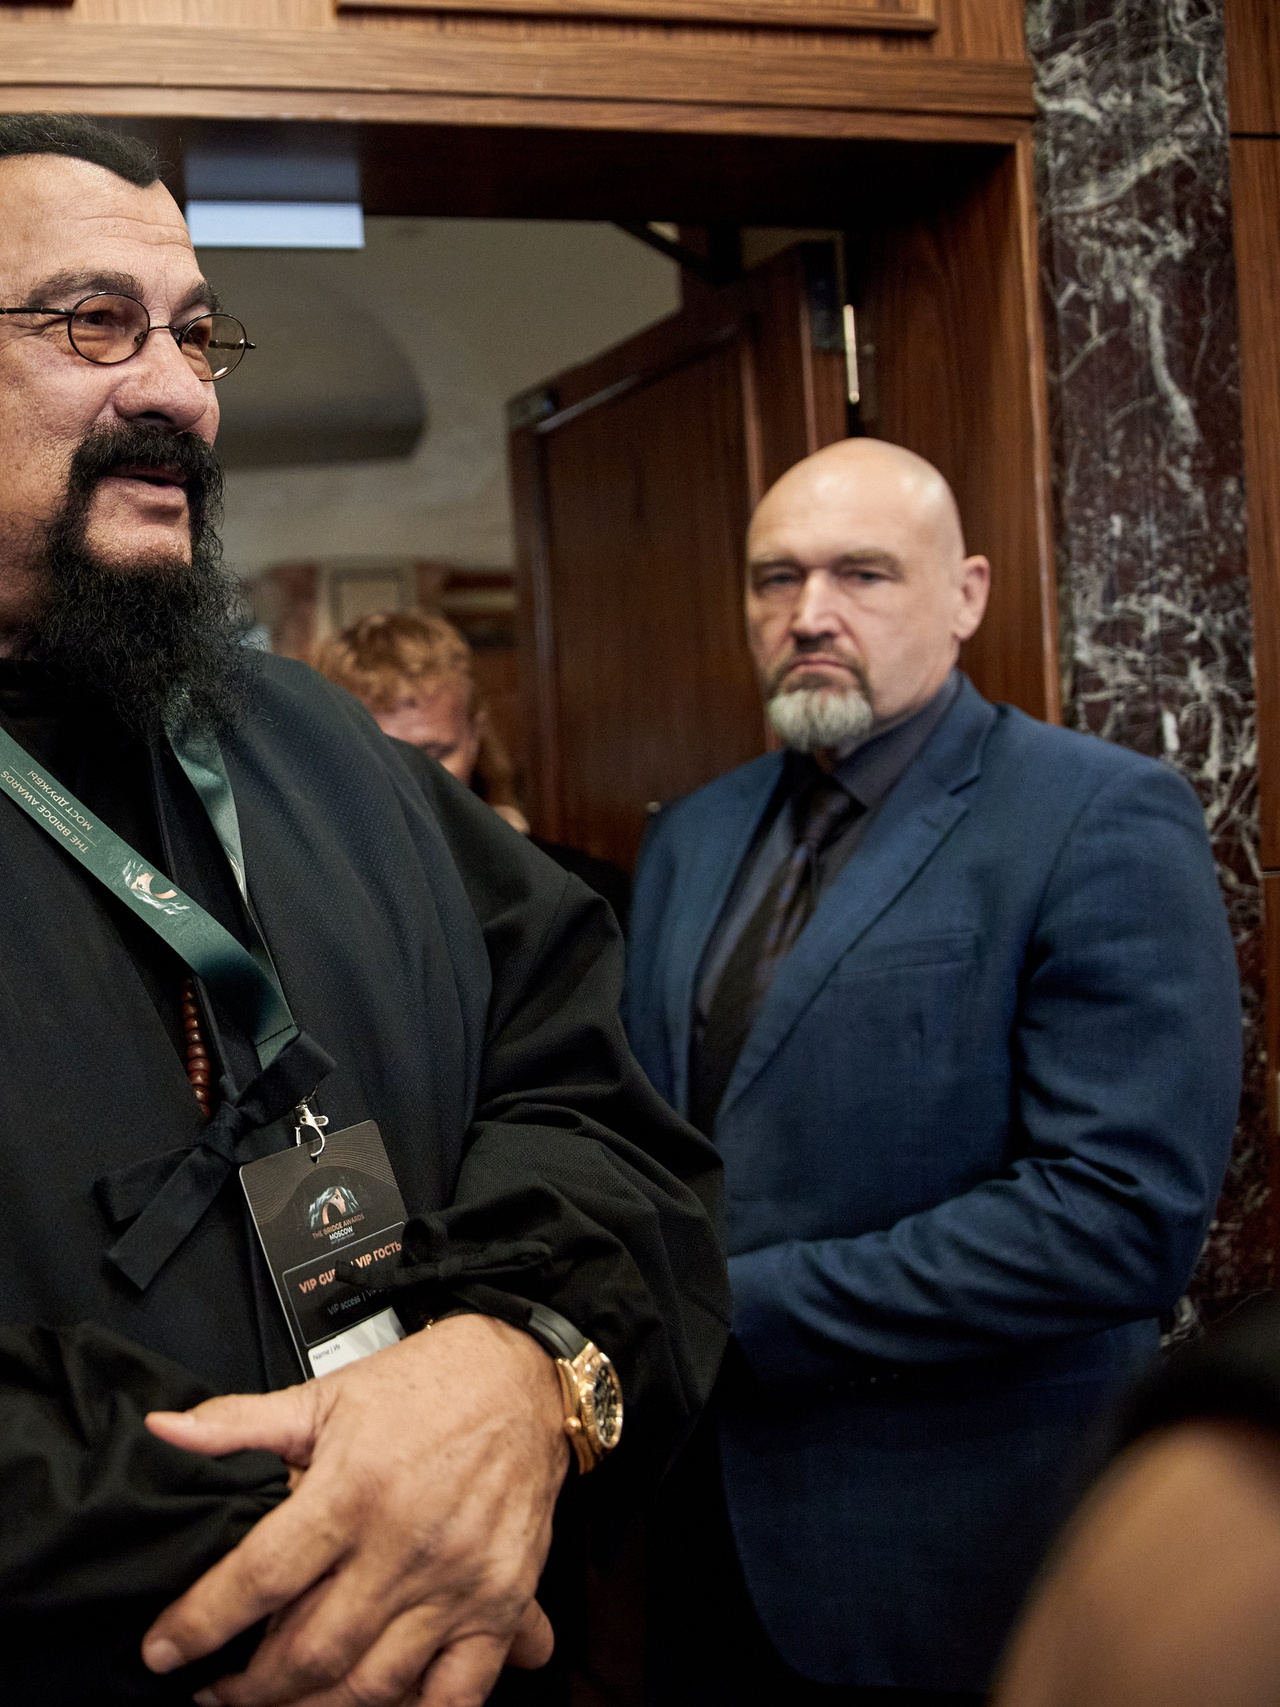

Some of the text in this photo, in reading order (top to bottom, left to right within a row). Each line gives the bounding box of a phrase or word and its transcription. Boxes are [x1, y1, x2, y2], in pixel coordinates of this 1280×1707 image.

[0, 770, 89, 854] THE BRIDGE AWARDS
[27, 770, 94, 832] МОСТ ДРУЖБЫ
[312, 1231, 323, 1240] THE
[323, 1221, 344, 1237] BRIDGE
[343, 1212, 365, 1227] AWARDS
[328, 1225, 354, 1241] MOSCOW
[298, 1277, 318, 1294] VIP
[355, 1253, 373, 1269] VIP
[372, 1240, 402, 1262] ГОСТЬ
